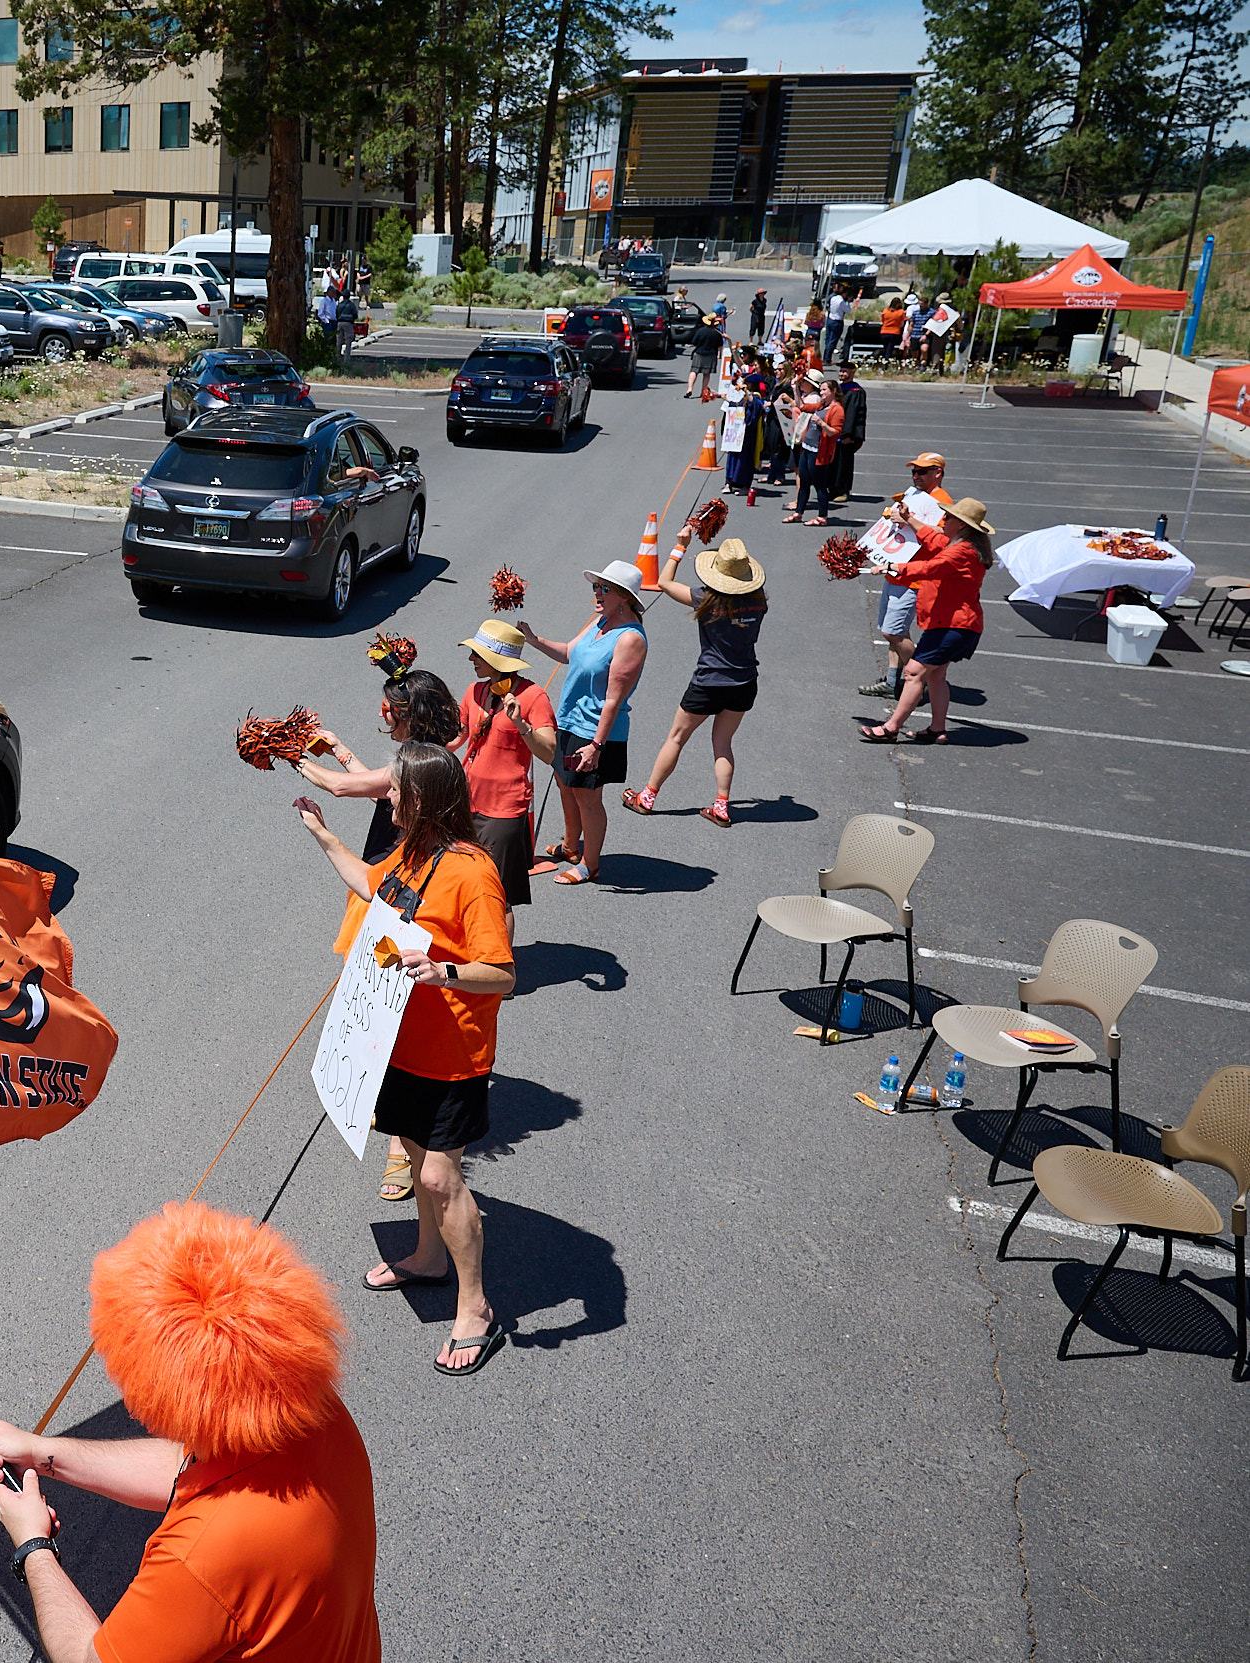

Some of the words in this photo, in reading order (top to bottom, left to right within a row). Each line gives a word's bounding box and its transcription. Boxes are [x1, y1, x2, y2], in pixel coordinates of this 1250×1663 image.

[1065, 297, 1118, 308] Cascades
[341, 967, 374, 1032] CLASS
[339, 1019, 353, 1044] OF
[18, 1056, 89, 1109] STATE
[319, 1025, 367, 1130] 2021
